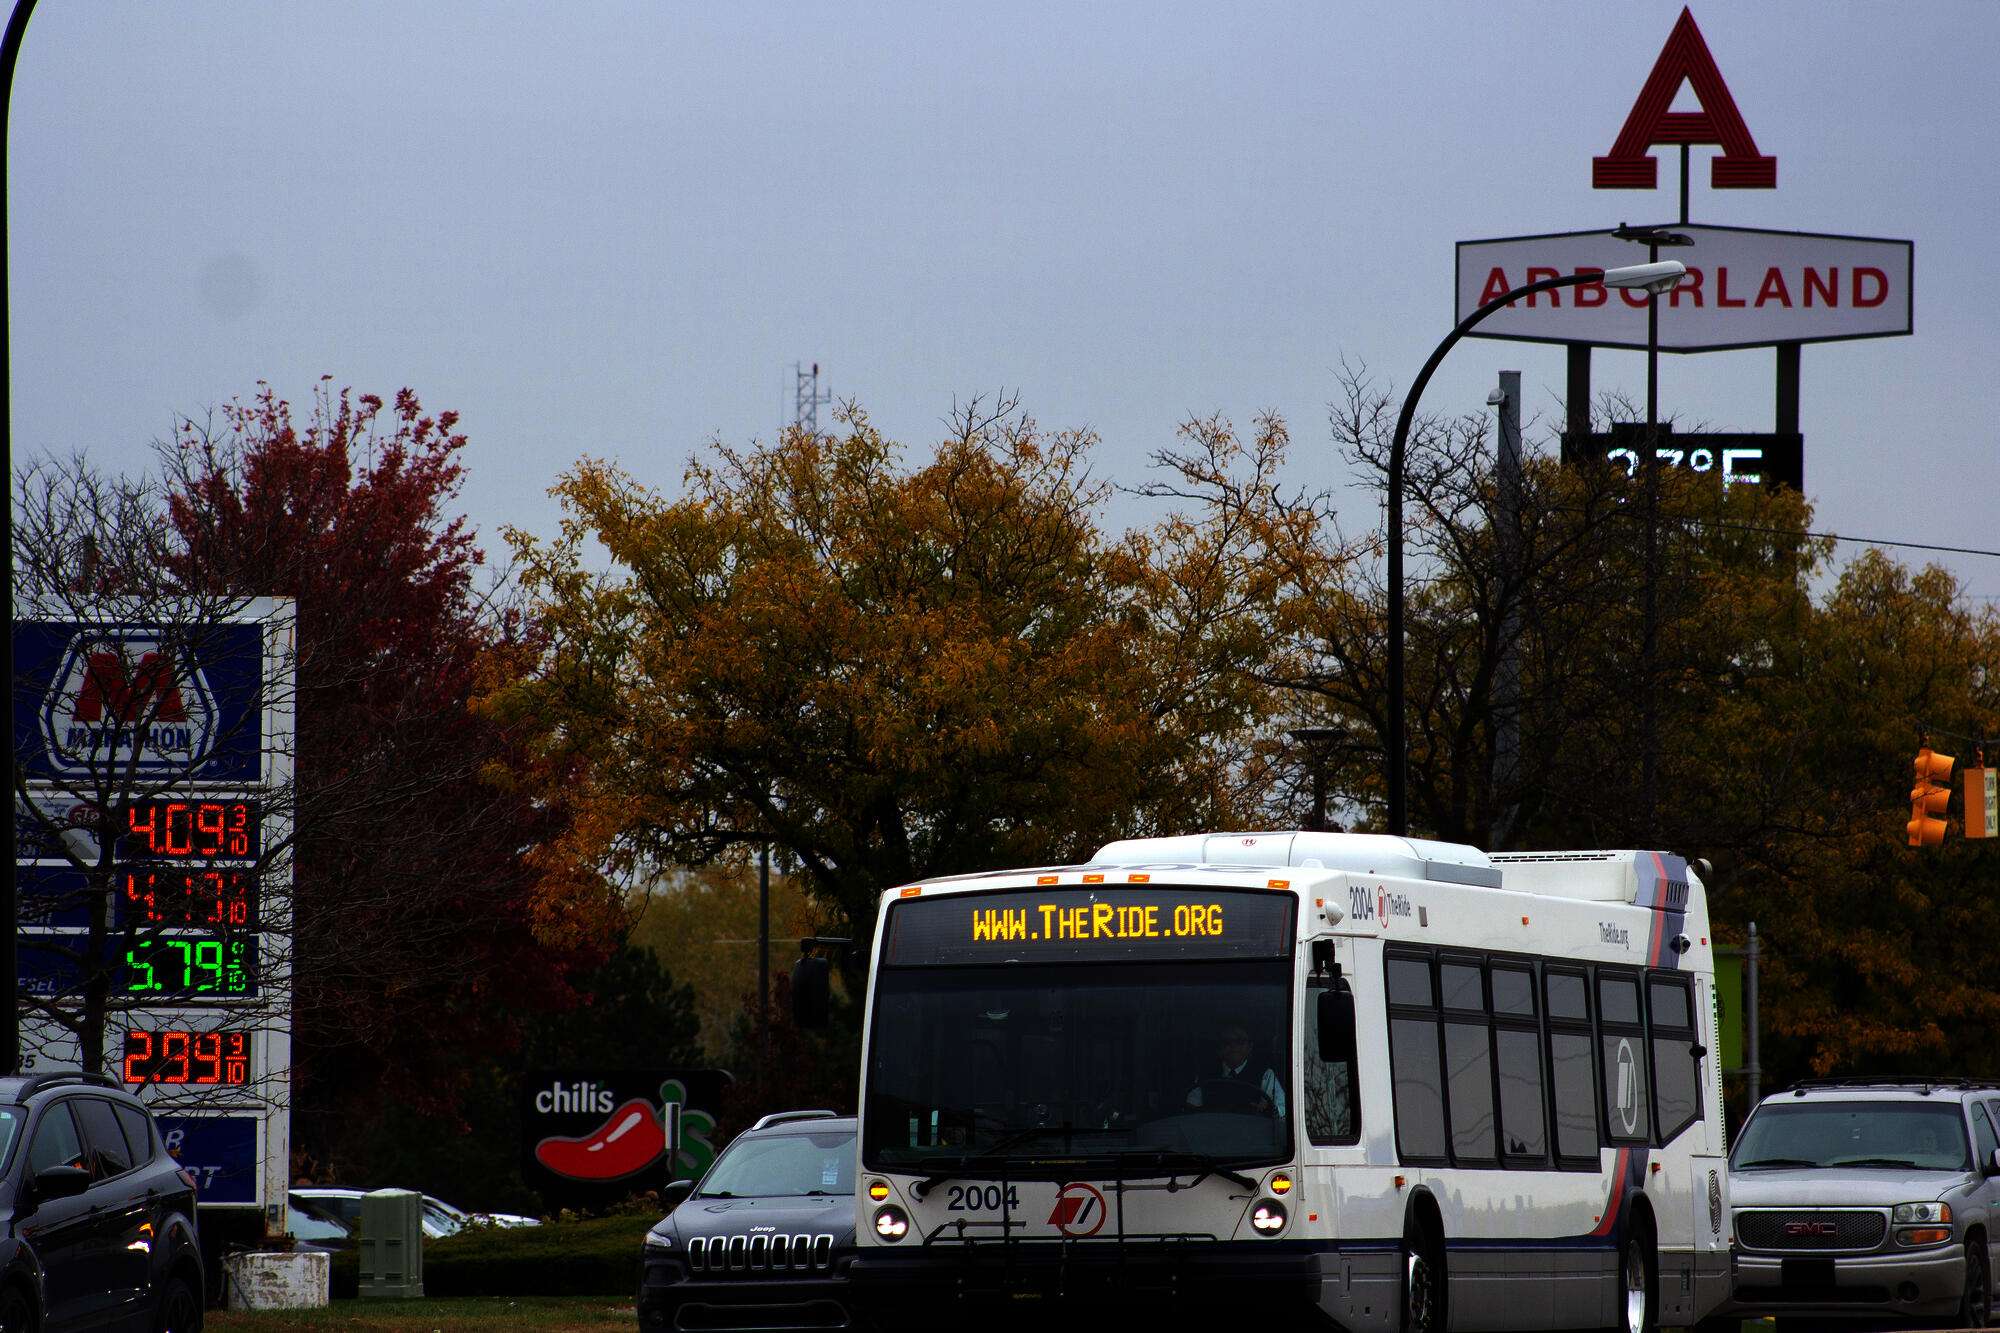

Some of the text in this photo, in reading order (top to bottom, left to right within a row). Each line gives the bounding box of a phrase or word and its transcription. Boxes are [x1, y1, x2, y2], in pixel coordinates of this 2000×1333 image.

[66, 728, 192, 748] MARAHON
[129, 804, 224, 856] 4.09
[1349, 886, 1375, 920] 2004
[126, 941, 223, 991] 5.79
[125, 1032, 221, 1083] 2.99
[947, 1185, 1020, 1211] 2004
[750, 1225, 777, 1233] Jeep
[1785, 1223, 1836, 1237] GMC
